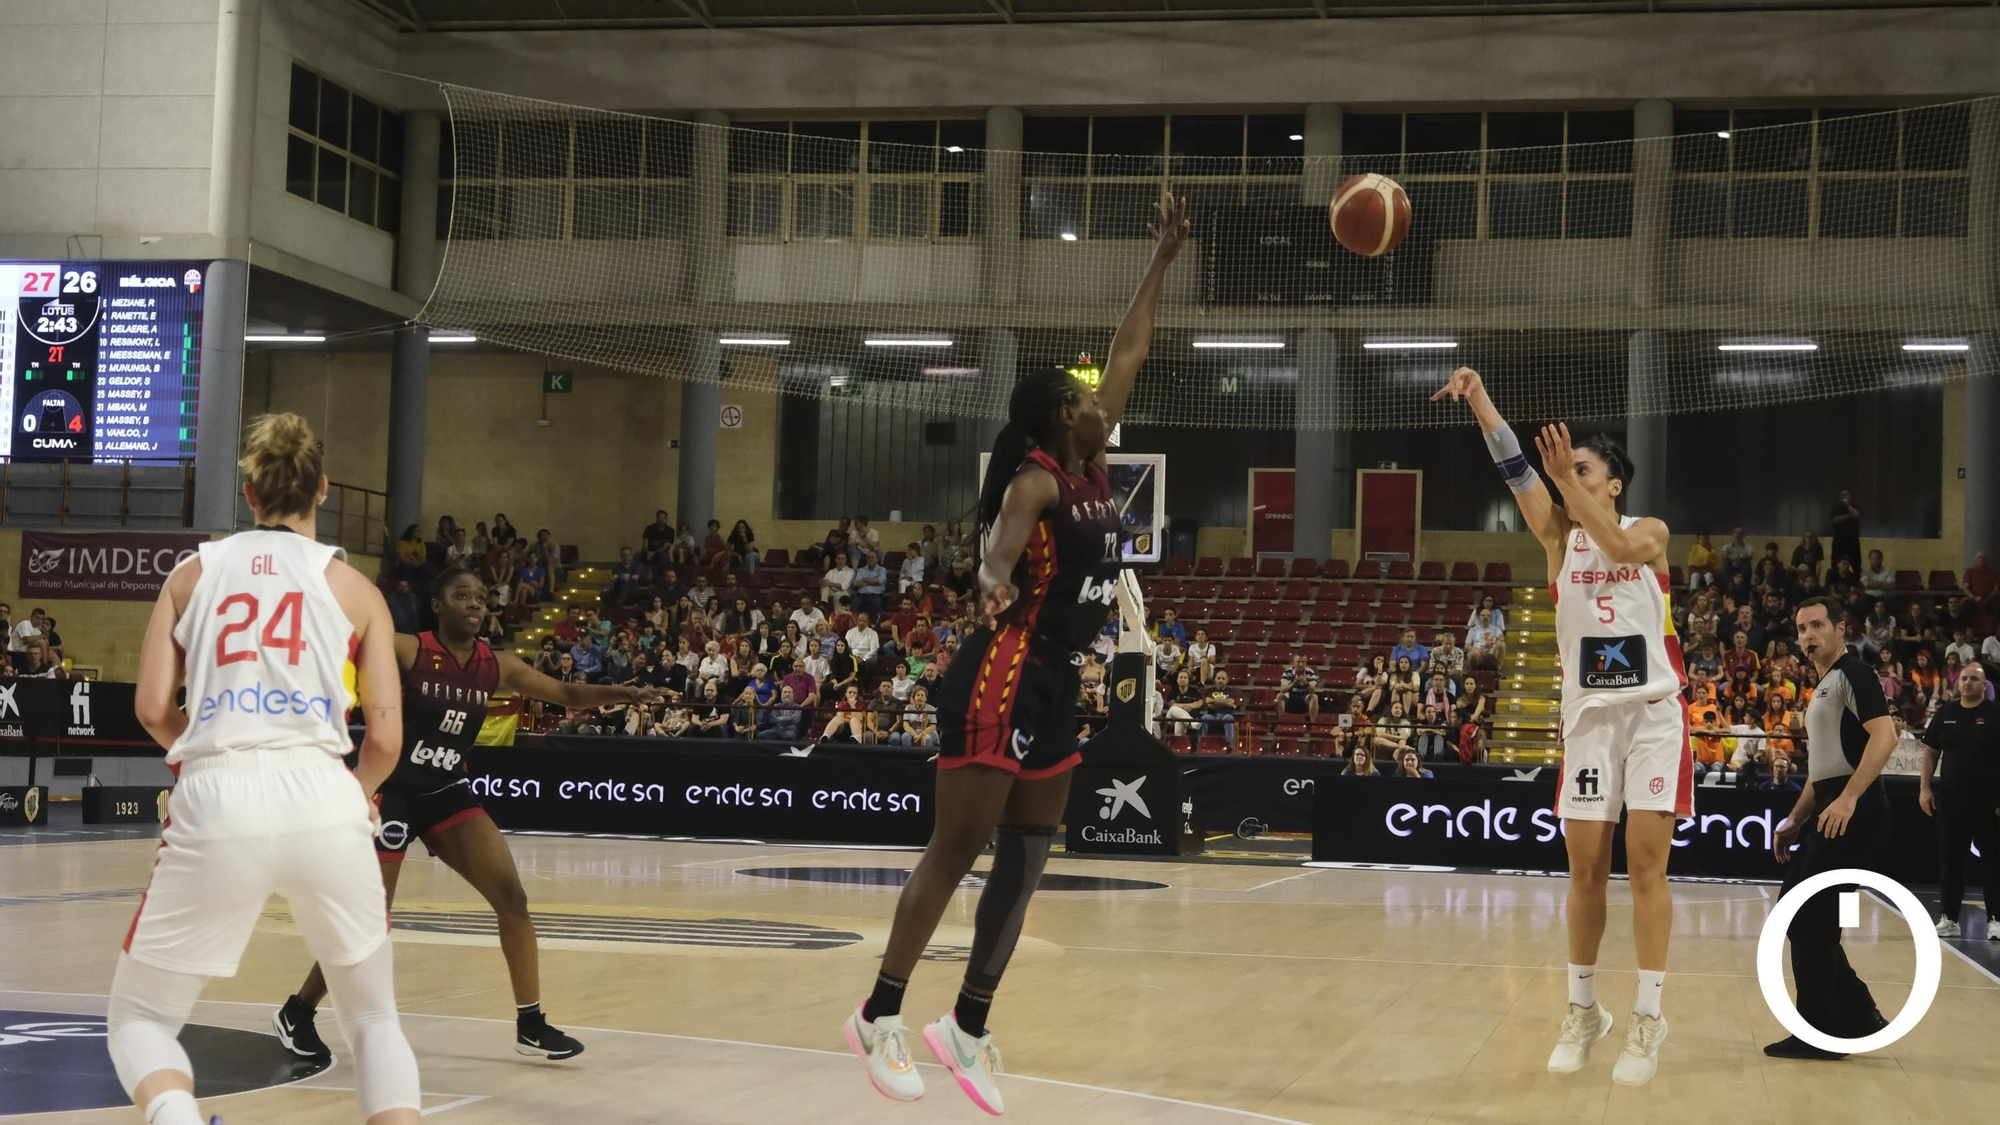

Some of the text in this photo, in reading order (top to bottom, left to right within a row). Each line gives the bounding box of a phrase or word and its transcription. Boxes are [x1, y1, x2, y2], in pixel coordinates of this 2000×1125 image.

[1260, 236, 1292, 245] LOCAL
[23, 272, 55, 292] 27
[63, 271, 97, 293] 26
[119, 274, 177, 288] BÉLGICA
[111, 299, 146, 308] MEZIANE,
[148, 299, 156, 307] R
[41, 306, 75, 316] LOTUS
[102, 312, 157, 321] 4 RAMETTE, E
[37, 317, 78, 333] 2:43
[101, 325, 158, 334] 6 DELAERE, A
[99, 338, 160, 347] 10 RESIMONT, L
[48, 346, 64, 363] 2T
[99, 351, 171, 360] 11 MEESSEMAN, E
[98, 364, 160, 373] 22 MUNUNGA, B
[97, 377, 151, 386] 23 GELDOF, S
[551, 375, 563, 390] K
[1221, 377, 1238, 393] M
[97, 390, 151, 399] 25 MASSEY, B
[42, 399, 66, 407] FALTAS
[96, 403, 147, 412] 31 MBAKA, M
[23, 414, 36, 432] 0
[68, 414, 83, 433] 4
[95, 416, 150, 425] 34 MASSEY, B
[95, 429, 149, 438] 35 VANLOO, J
[94, 442, 158, 451] 55 ALLEMAND, J
[1101, 532, 1119, 562] 22
[251, 554, 278, 575] GIL
[1571, 567, 1642, 584] ESPAÑA
[27, 579, 160, 592] Instituto Municipal de Deportes
[1596, 596, 1615, 624] 5
[216, 592, 307, 667] 24
[1586, 673, 1640, 686] CaixaBank
[70, 681, 91, 725] fi
[199, 681, 331, 722] endesa
[438, 709, 467, 735] 66
[67, 726, 96, 736] network
[1575, 768, 1599, 795] fi
[464, 774, 920, 813] desa endesa endesa endesa
[115, 802, 139, 815] 1923
[1386, 799, 1567, 842] endes
[1081, 825, 1163, 845] CaixaBank
